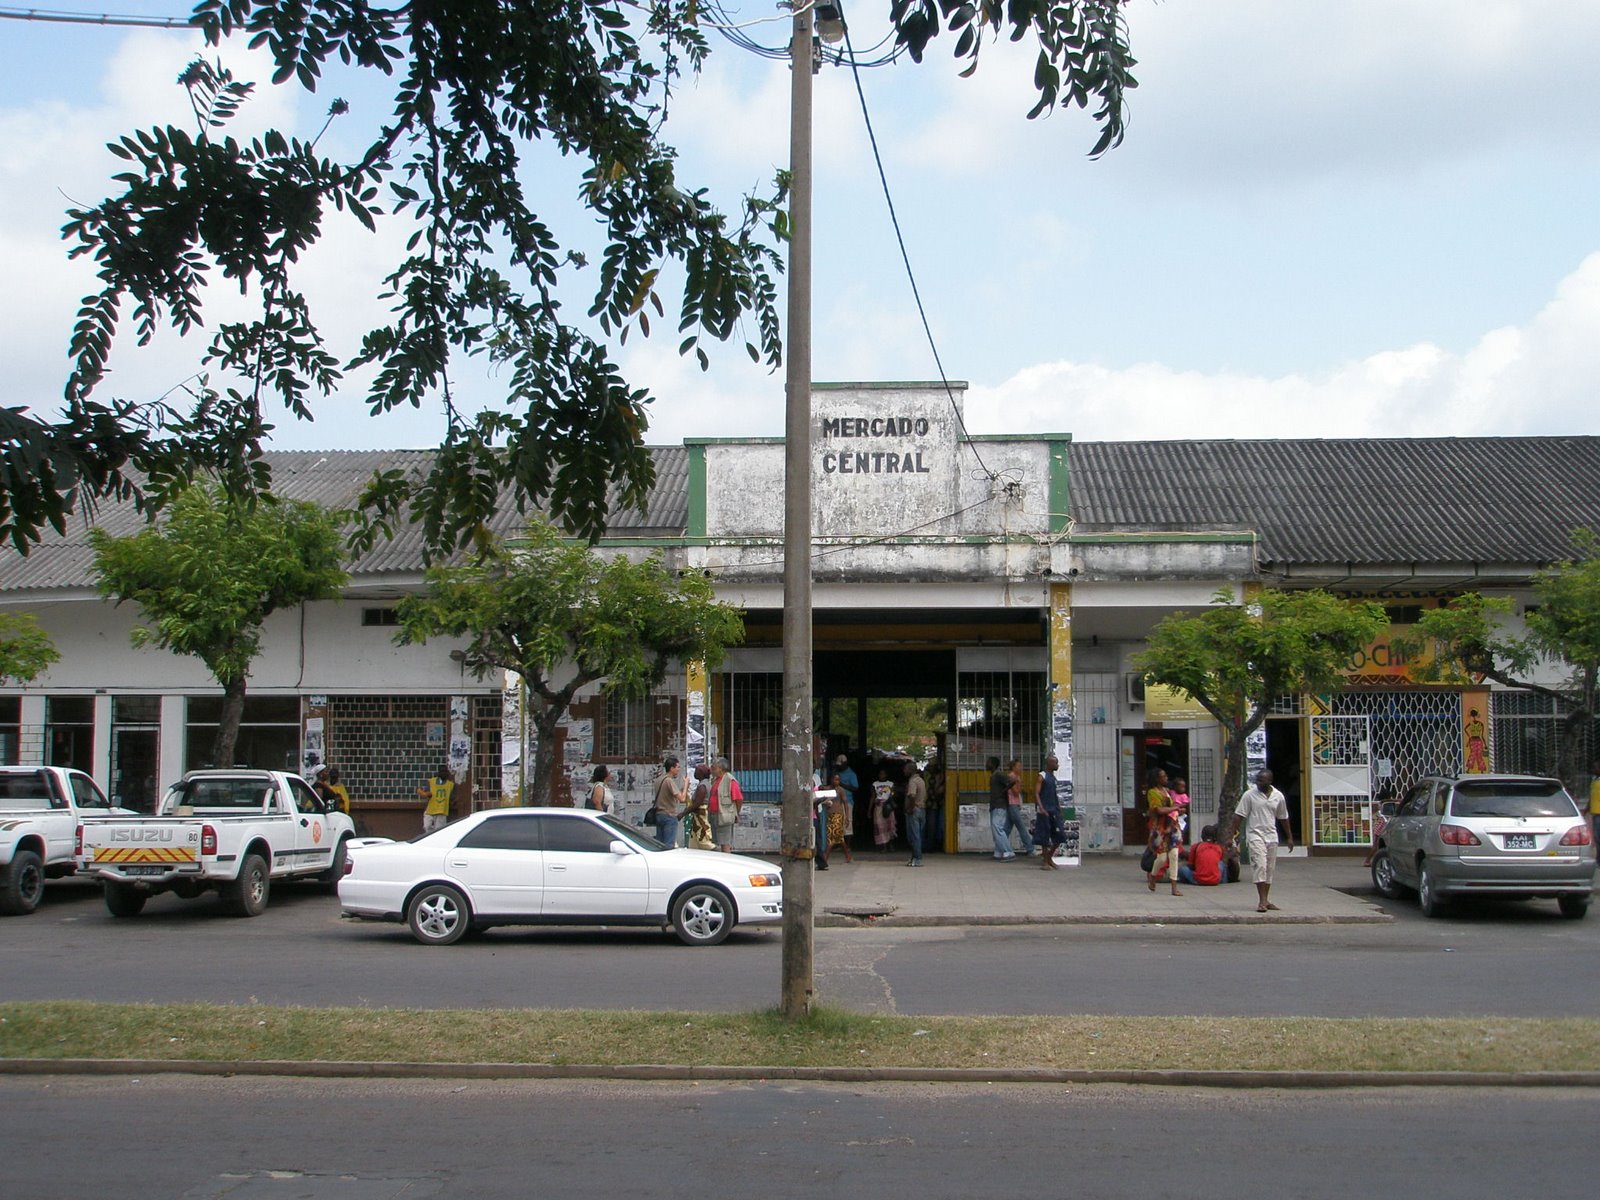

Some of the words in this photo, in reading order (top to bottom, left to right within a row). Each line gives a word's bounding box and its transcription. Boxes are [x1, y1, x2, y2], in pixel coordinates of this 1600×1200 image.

[822, 417, 929, 438] MERCADO
[822, 452, 930, 473] CENTRAL
[110, 828, 173, 842] ISUZU
[188, 833, 198, 842] 80
[1506, 840, 1534, 849] 352-MC
